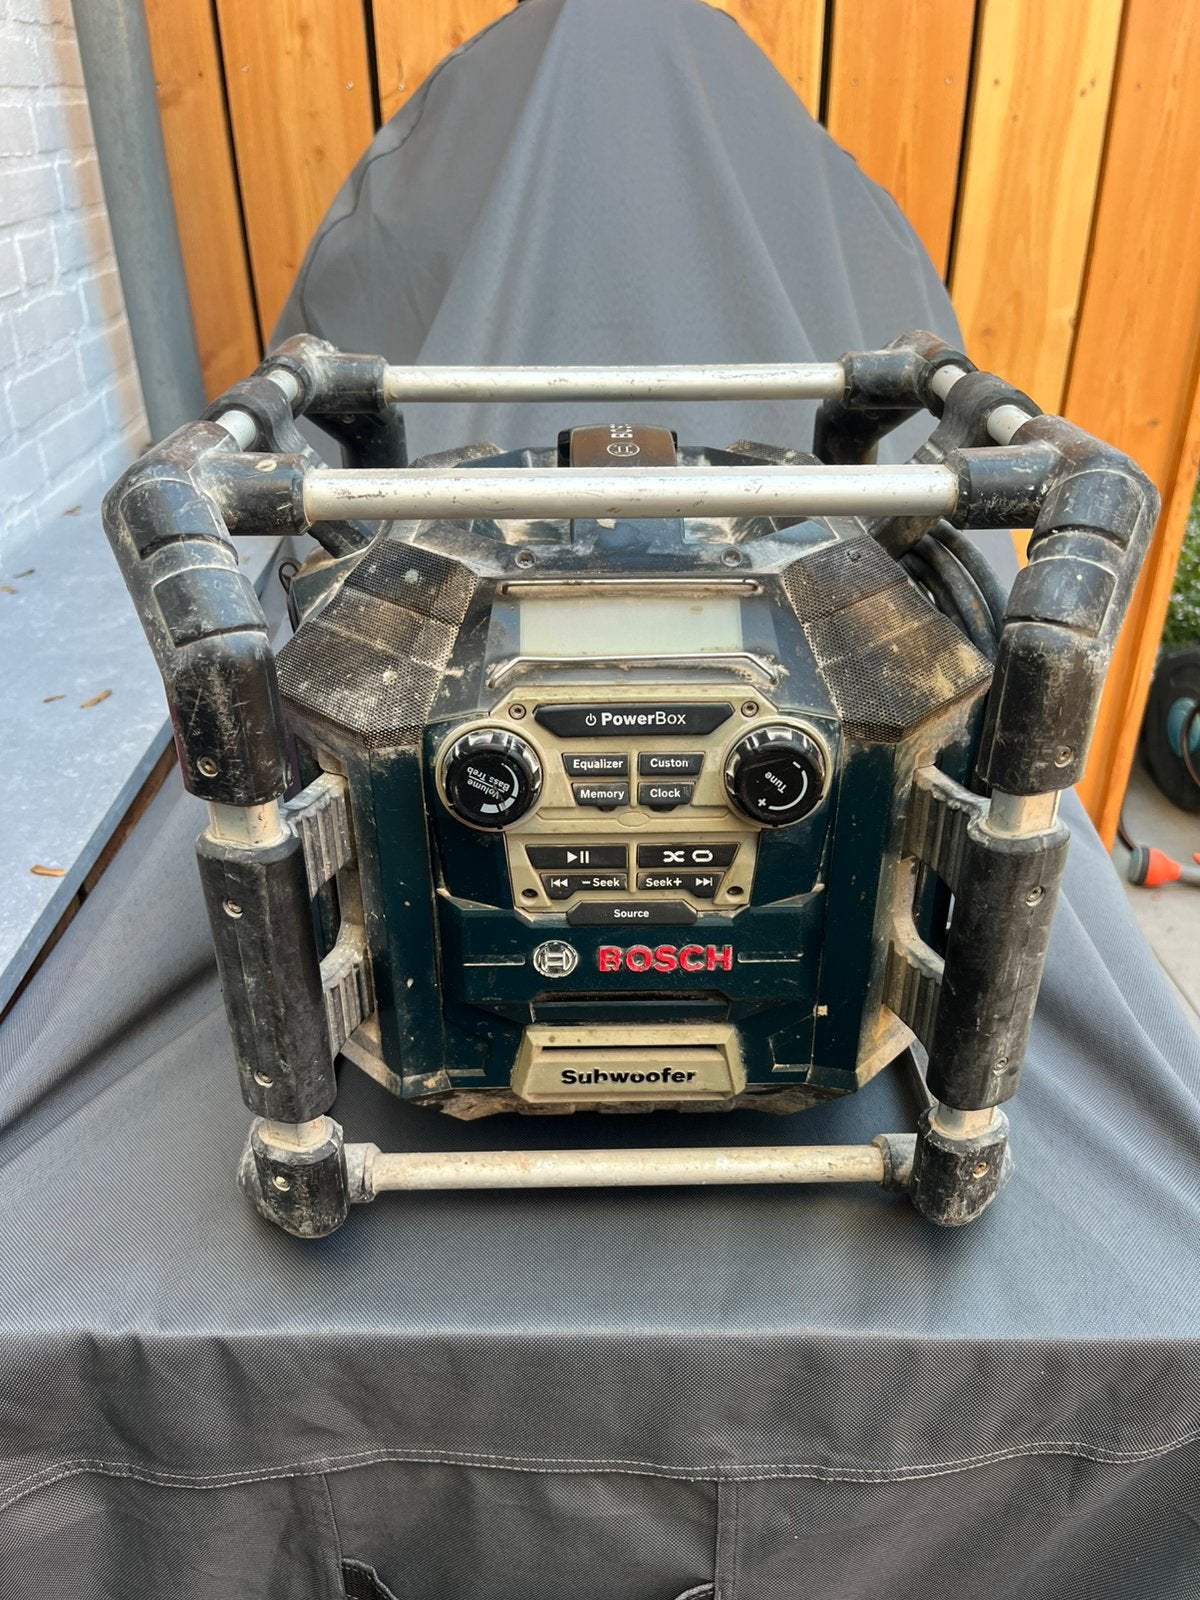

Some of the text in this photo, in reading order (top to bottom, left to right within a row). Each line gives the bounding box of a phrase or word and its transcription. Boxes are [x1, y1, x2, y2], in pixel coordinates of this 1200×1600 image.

[601, 711, 687, 726] PowerBox
[573, 759, 624, 771] Equalizer
[466, 766, 511, 792] Bass Treb
[764, 771, 787, 794] Tune
[467, 778, 499, 800] Volume
[580, 789, 625, 800] Memory
[649, 788, 681, 798] Clock
[613, 909, 650, 918] Source
[597, 944, 733, 973] BOSCH
[561, 1067, 697, 1085] Subwoofer
